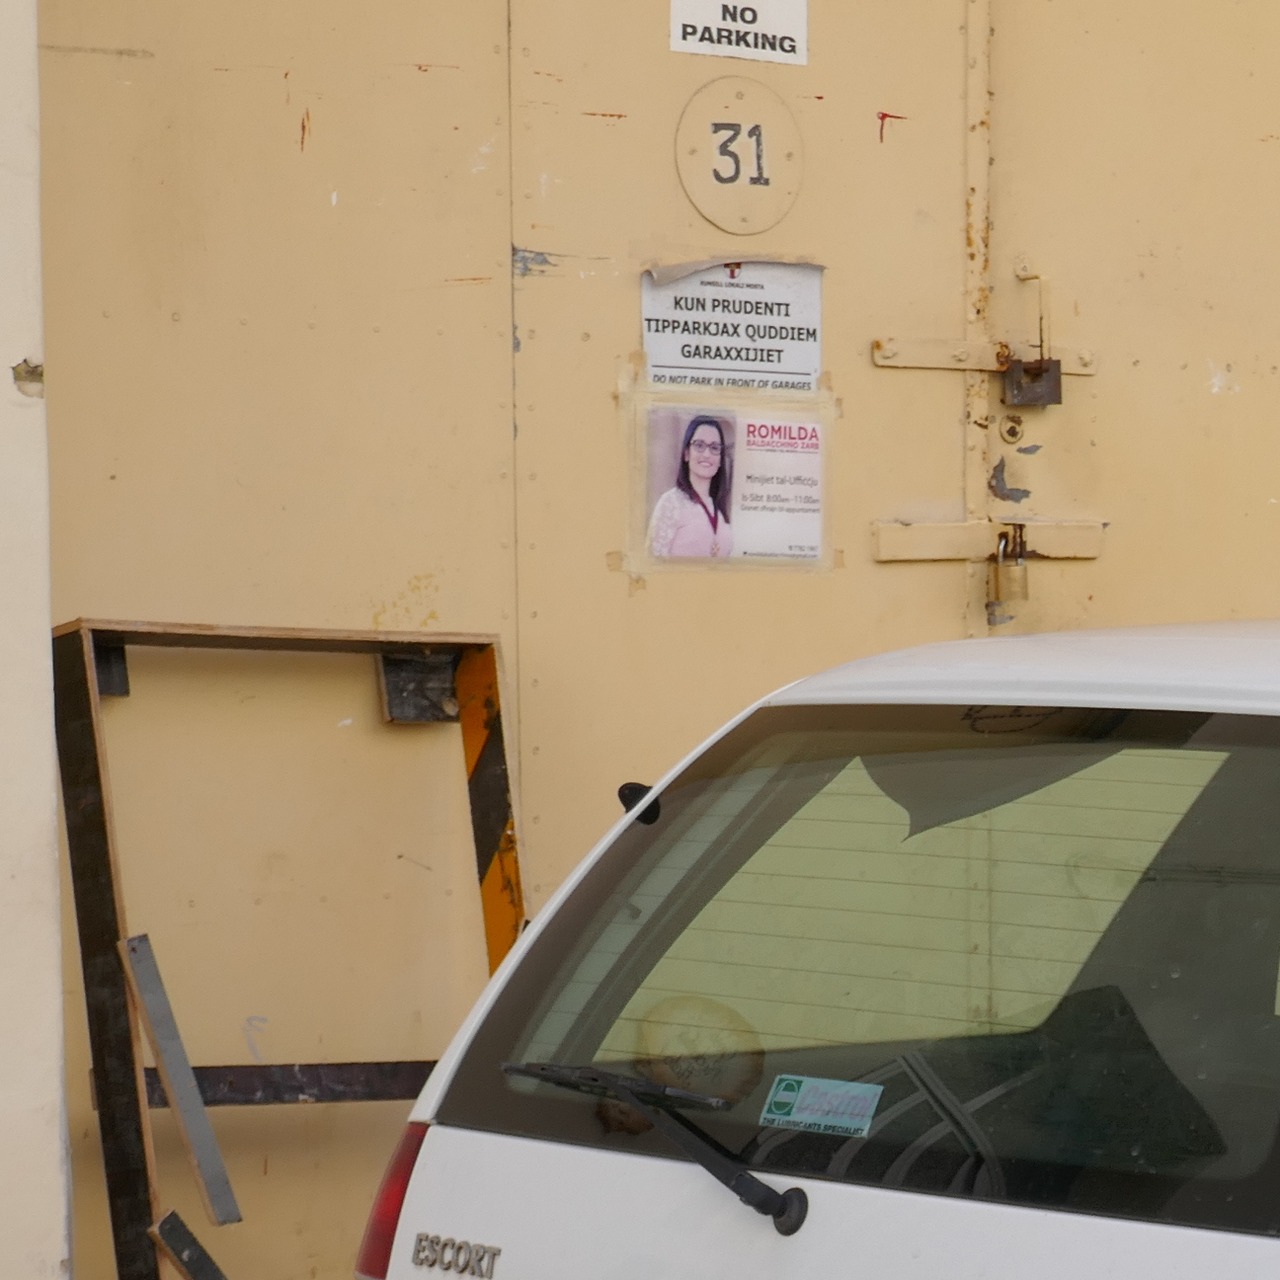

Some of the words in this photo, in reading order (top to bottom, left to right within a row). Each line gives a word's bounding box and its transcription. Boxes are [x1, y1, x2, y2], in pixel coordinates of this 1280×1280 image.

[721, 4, 758, 25] NO
[681, 23, 797, 54] PARKING
[711, 122, 770, 186] 31
[674, 296, 706, 312] KUN
[711, 298, 790, 317] PRUDENTI
[645, 318, 740, 338] TIPPARKJAX
[745, 324, 818, 343] QUDDIEM
[681, 344, 784, 364] GARAXXIJIET
[652, 374, 667, 384] DO
[669, 375, 688, 385] NOT
[690, 376, 712, 387] PARK
[714, 377, 724, 387] IN
[726, 378, 756, 389] FRONT
[757, 379, 770, 389] OF
[771, 380, 811, 391] GARAGES
[746, 423, 819, 442] ROMILDA
[822, 1124, 864, 1136] SPECIALIST
[412, 1232, 502, 1280] ESCORT
